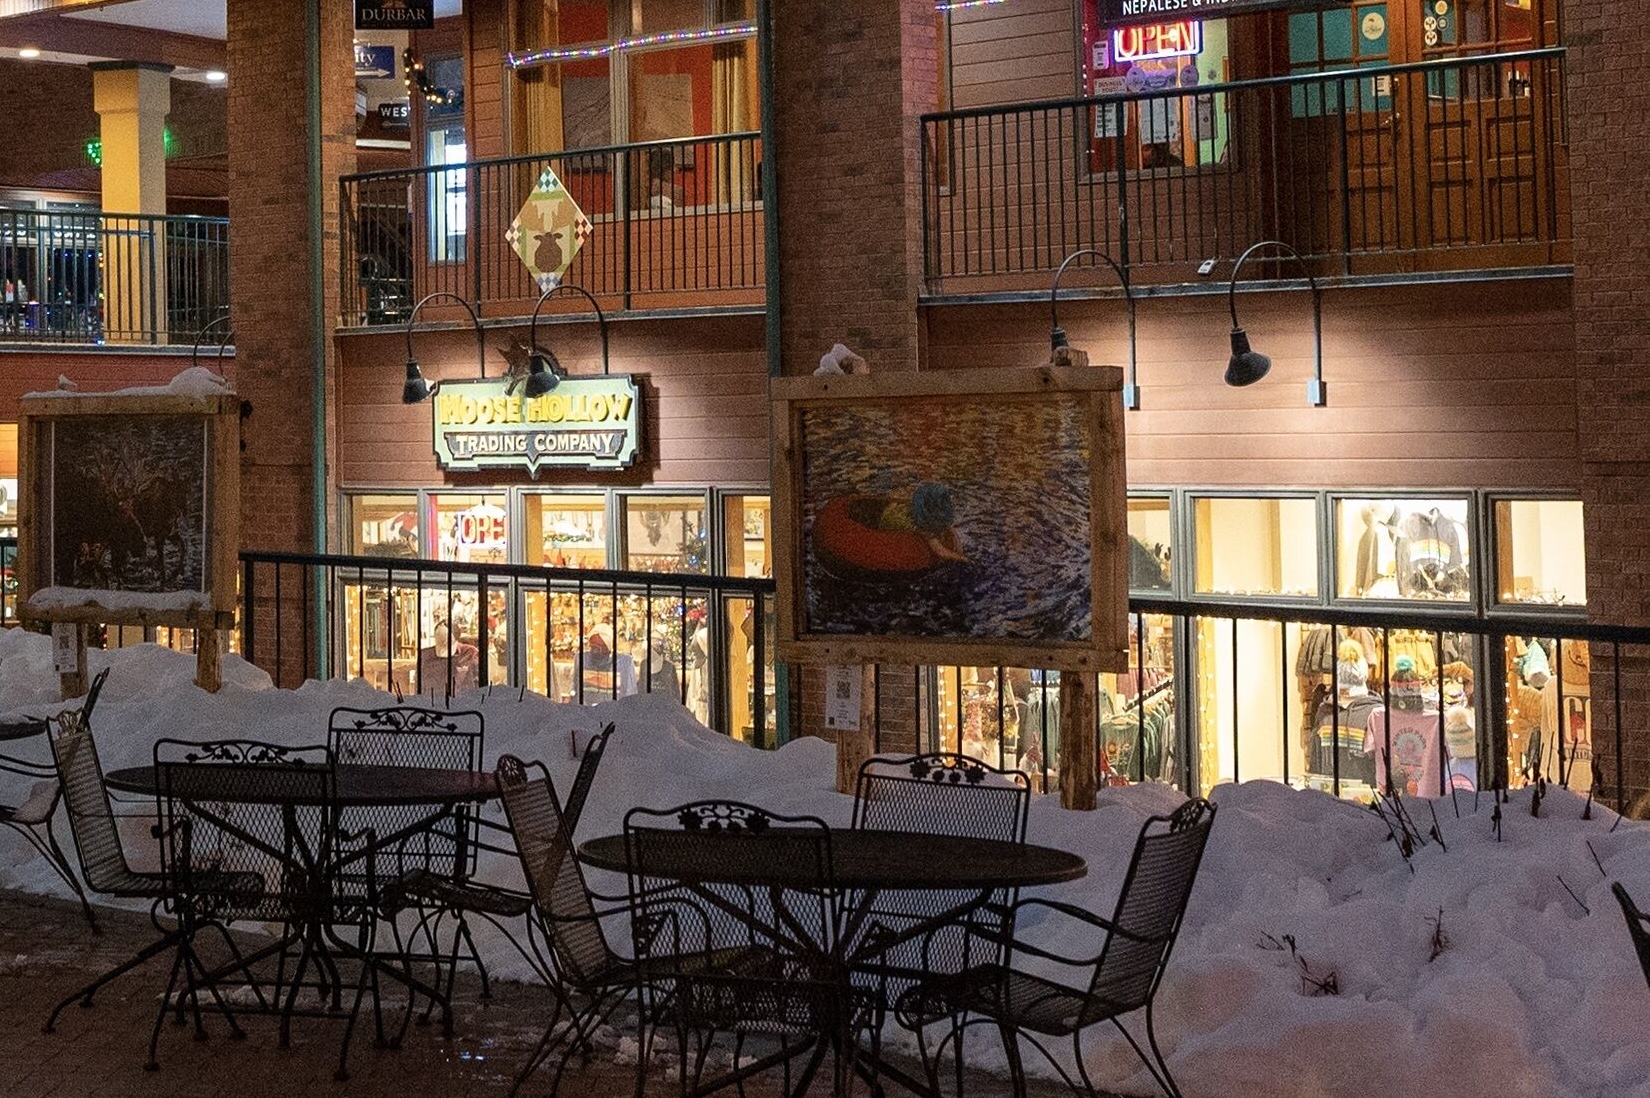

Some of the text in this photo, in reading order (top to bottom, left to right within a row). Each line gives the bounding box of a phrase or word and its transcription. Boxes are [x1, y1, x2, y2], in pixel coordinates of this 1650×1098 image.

[362, 8, 426, 21] DURBAR
[1118, 19, 1194, 58] OPEN
[355, 47, 376, 67] ity
[380, 106, 408, 118] WES
[439, 393, 632, 424] MOOSE HOLLOW
[455, 432, 616, 452] TRADING COMPANY
[460, 513, 506, 544] OPE
